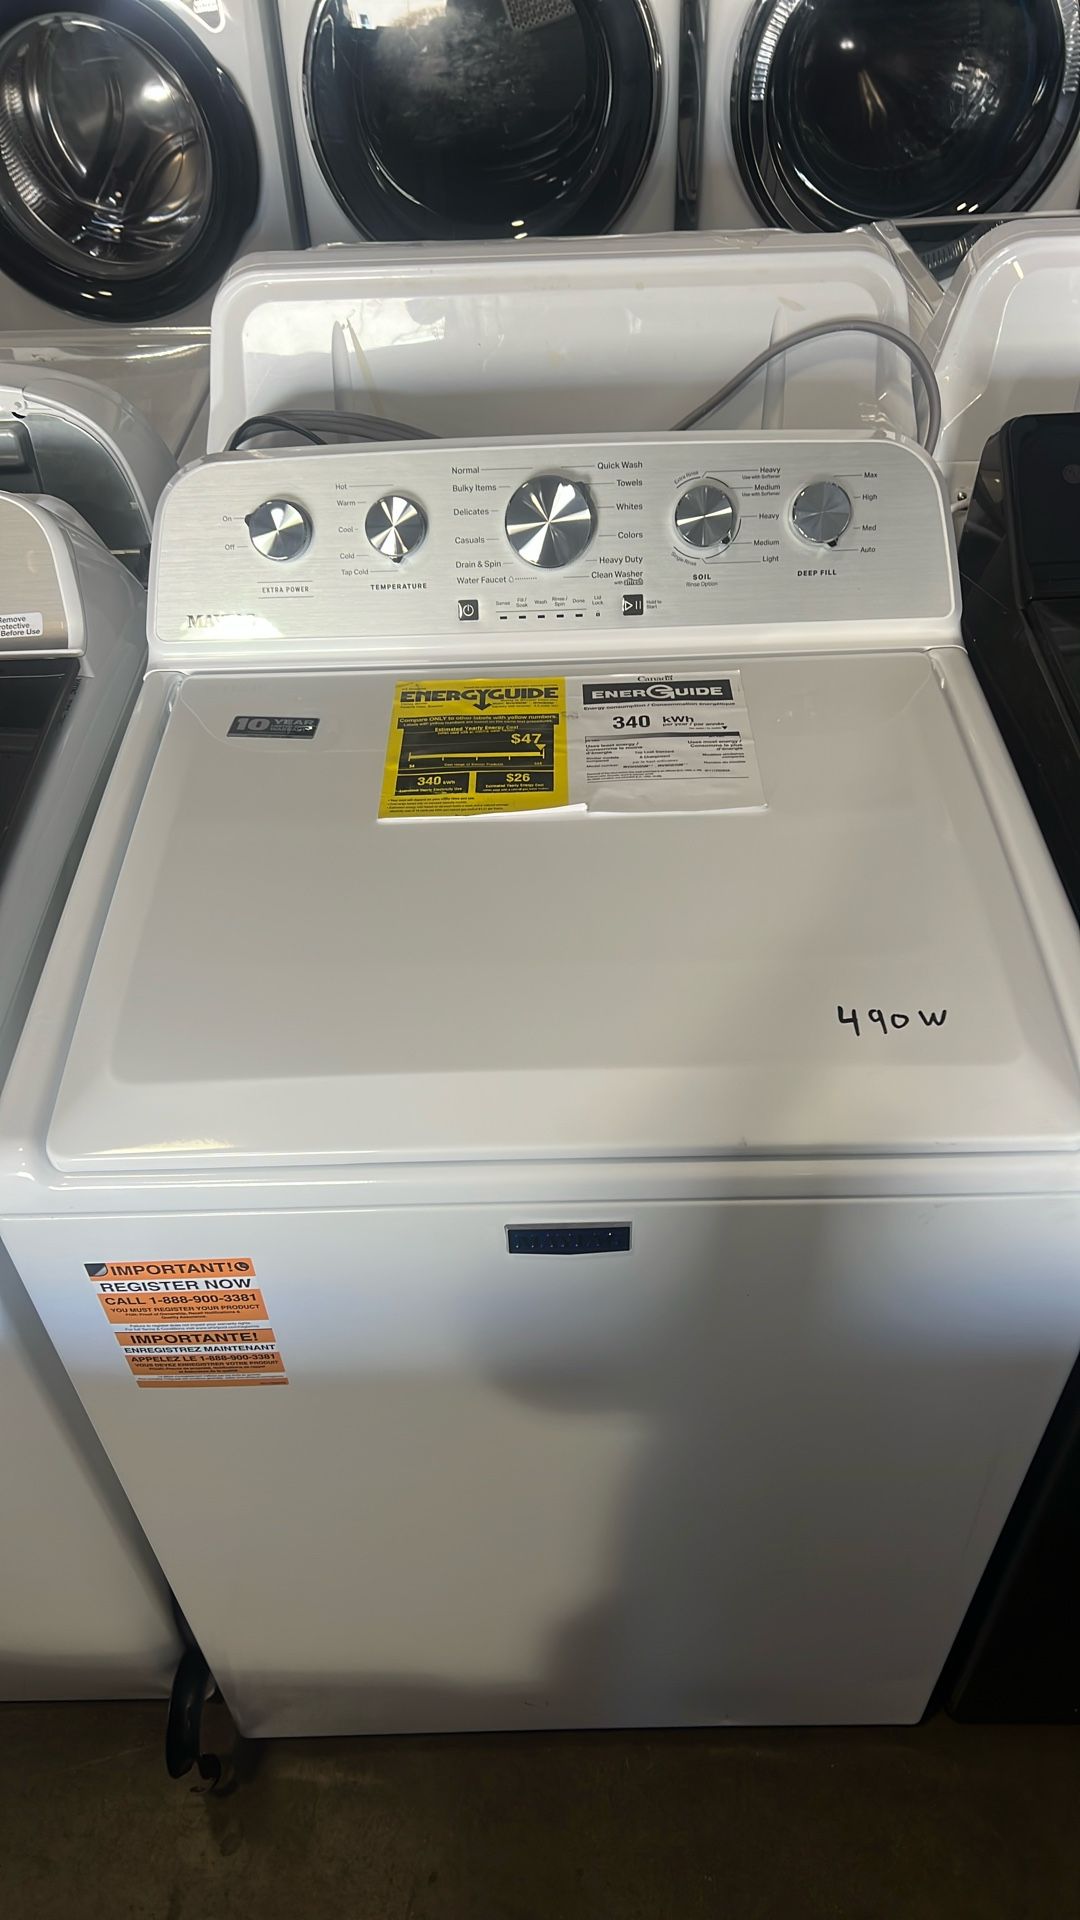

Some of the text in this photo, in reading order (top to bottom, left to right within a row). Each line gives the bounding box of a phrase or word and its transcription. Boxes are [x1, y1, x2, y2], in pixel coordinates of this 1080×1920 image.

[452, 484, 473, 493] Bulky
[484, 560, 501, 568] Spin
[625, 556, 643, 564] Duty
[400, 687, 559, 703] ENERGYGUIDE
[237, 718, 270, 730] 10
[613, 715, 650, 729] 340
[511, 734, 541, 744] $47
[417, 776, 441, 785] 340
[506, 773, 530, 782] $26
[110, 1262, 233, 1276] IMPORTANT!
[100, 1279, 251, 1292] REGISTER NOW
[105, 1294, 257, 1305] CALL 1-888-900-3381
[130, 1333, 258, 1344] IMPORTANTE!
